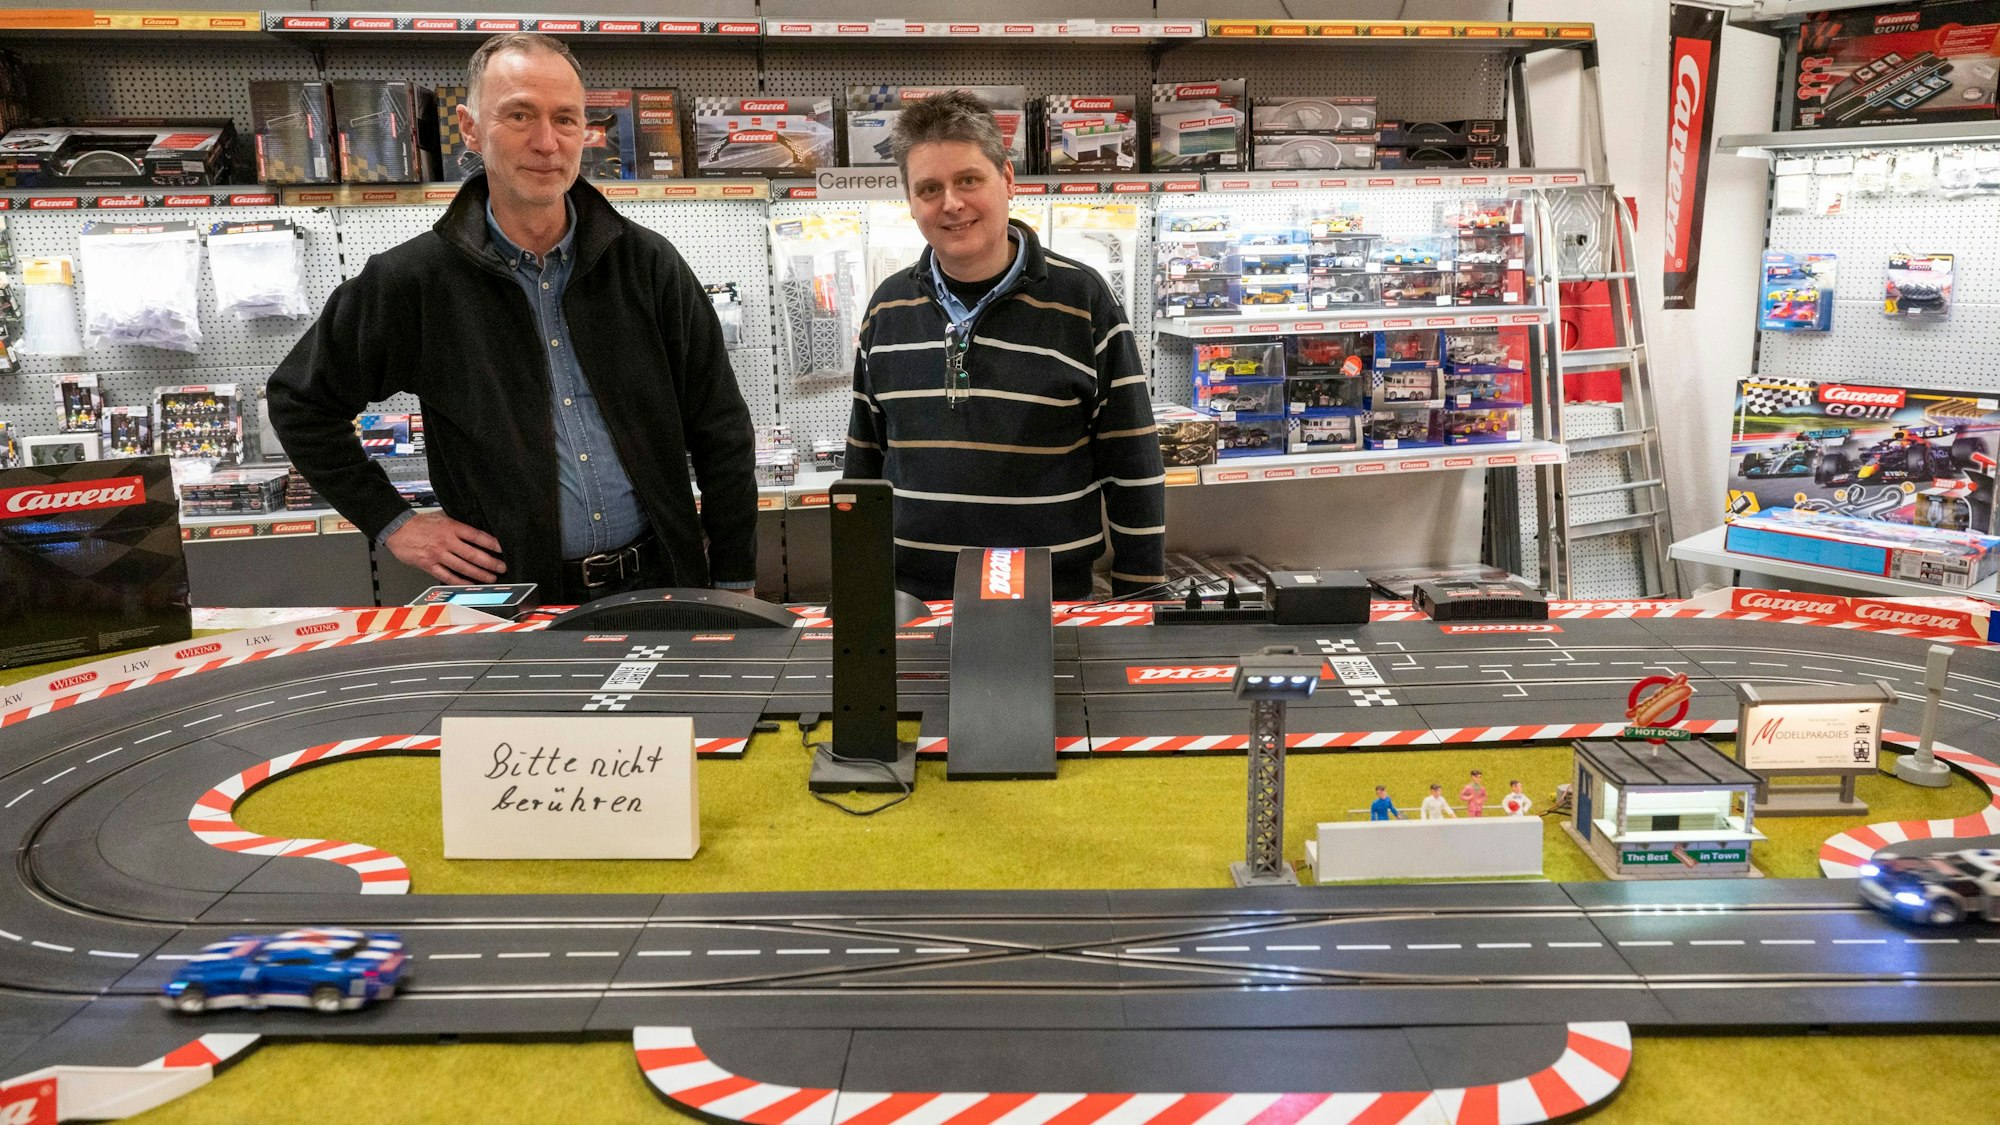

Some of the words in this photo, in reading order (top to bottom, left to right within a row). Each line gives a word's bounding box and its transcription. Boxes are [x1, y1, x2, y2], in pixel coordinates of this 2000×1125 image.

[288, 19, 326, 28] Carrera
[353, 20, 391, 28] Carrera
[416, 21, 454, 29] Carrera
[480, 21, 517, 30] Carrera
[541, 21, 578, 30] Carrera
[602, 22, 639, 31] Carrera
[662, 23, 698, 32] Carrera
[721, 24, 758, 33] Carrera
[1179, 86, 1217, 95] Carrera
[744, 101, 785, 110] Carrera
[1074, 100, 1111, 109] Carrera
[642, 110, 672, 118] Carrera
[733, 133, 773, 142] Carrera
[1666, 54, 1700, 258] Carrera
[819, 172, 897, 190] Carrera
[1064, 184, 1096, 192] Carrera
[1116, 183, 1148, 192] Carrera
[1167, 182, 1199, 191] Carrera
[33, 199, 76, 208] Carrera
[101, 198, 142, 206] Carrera
[167, 197, 208, 206] Carrera
[233, 196, 272, 205] Carrera
[1824, 388, 1900, 406] Carrera
[1825, 404, 1896, 419] GO!!!
[7, 484, 137, 513] Carrera
[213, 526, 251, 536] Carrera
[275, 522, 313, 532] Carrera
[1548, 601, 1682, 611] arrera
[1740, 591, 1837, 614] Carrera
[1856, 603, 1962, 630] Carrera
[298, 623, 339, 636] WIKING
[1451, 625, 1554, 633] Carrera
[246, 635, 272, 647] LKW
[178, 644, 220, 658] WIKING
[124, 660, 151, 673] LKW
[1334, 661, 1359, 680] FINISH
[1352, 661, 1378, 680] START
[607, 667, 634, 685] FINISH
[625, 667, 651, 685] START
[1139, 667, 1237, 680] rera
[52, 672, 95, 690] WIKING
[1635, 728, 1656, 736] HOT
[1657, 728, 1680, 737] DOG
[1752, 717, 1849, 746] MODELLPARADIES
[484, 742, 577, 779] Bitte
[590, 745, 664, 778] nicht
[491, 785, 643, 813] berühren
[1627, 853, 1645, 861] The
[1646, 853, 1668, 861] Best
[1700, 852, 1708, 860] in
[1709, 852, 1740, 860] Town
